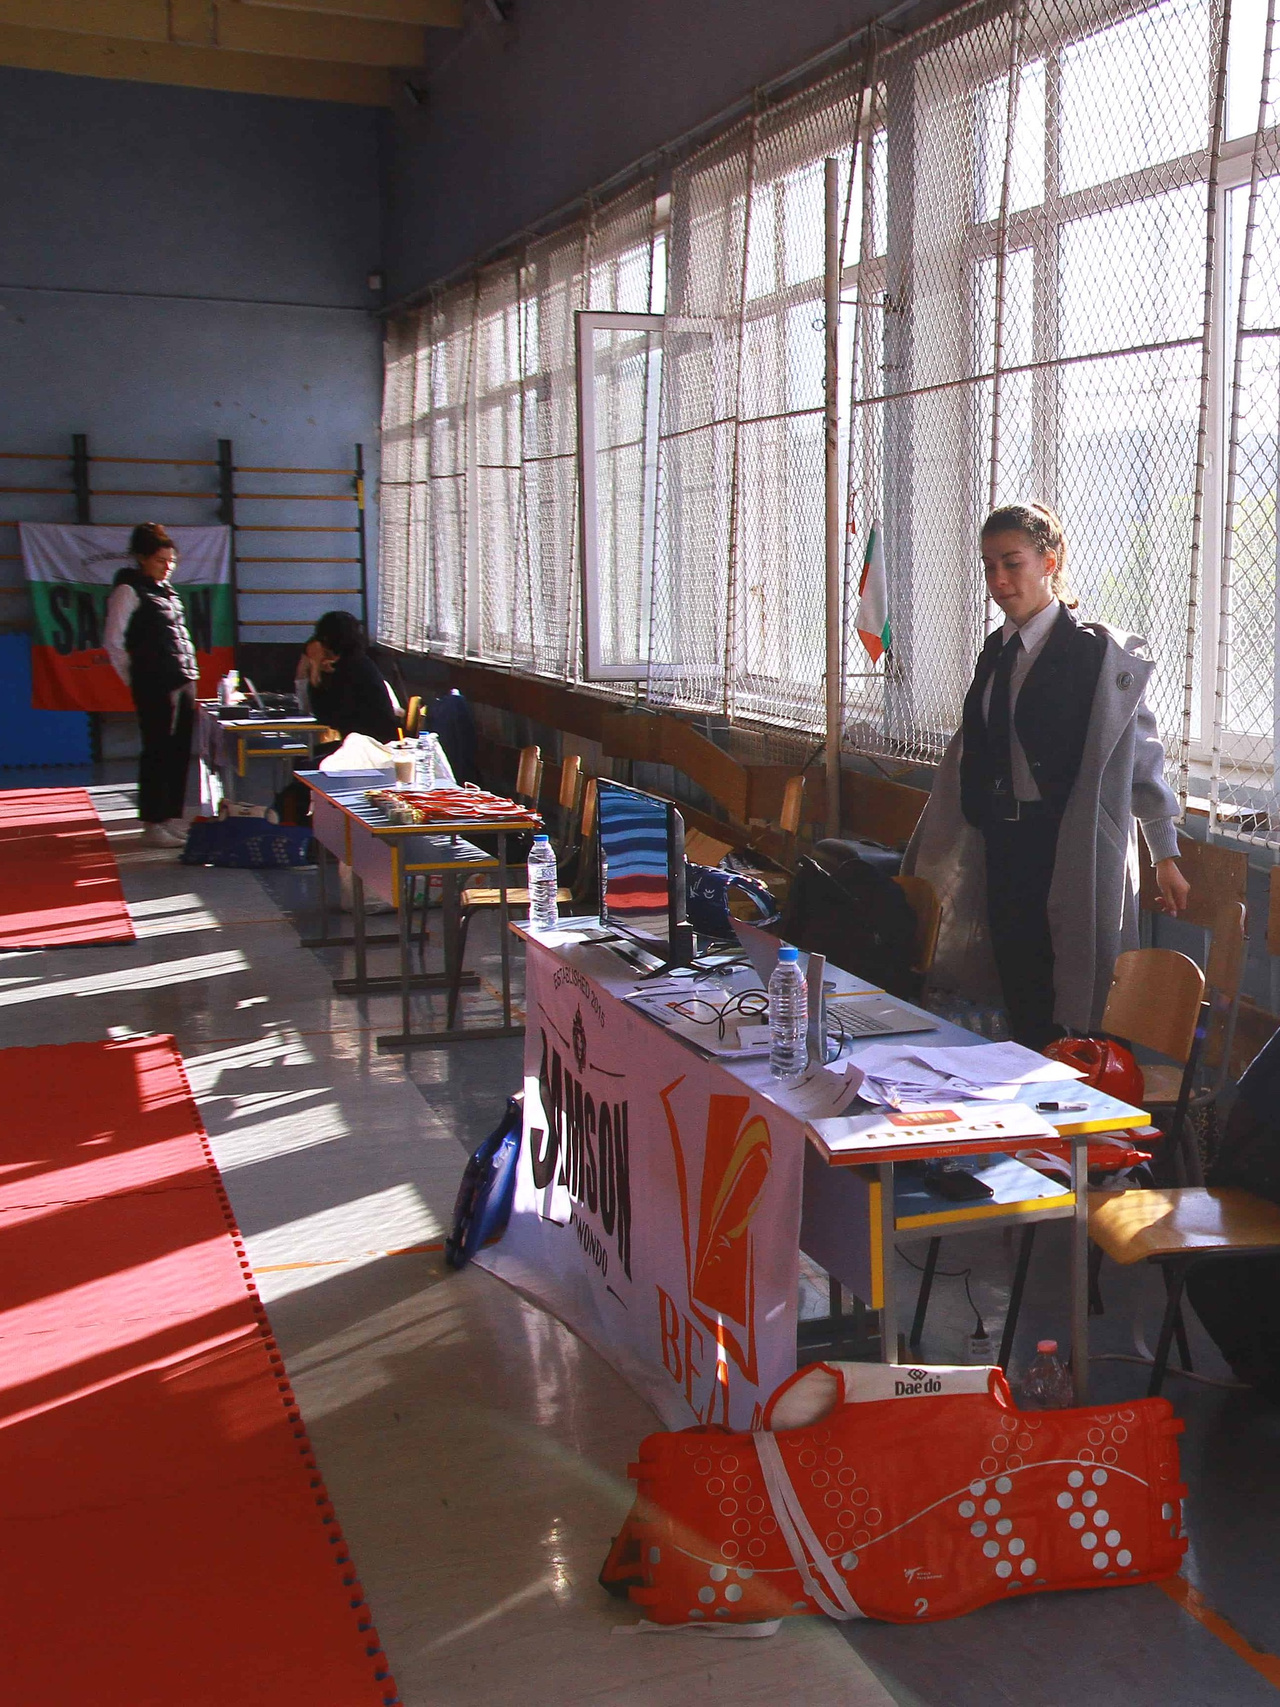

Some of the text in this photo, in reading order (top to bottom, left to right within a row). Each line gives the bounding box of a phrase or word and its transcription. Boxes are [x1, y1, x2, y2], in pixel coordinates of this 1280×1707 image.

[553, 966, 606, 1029] ESTABLISHED 2015
[530, 1026, 632, 1284] SAMSON
[573, 1211, 608, 1279] WONDO
[894, 1378, 943, 1396] Daedo
[914, 1597, 929, 1617] 2
